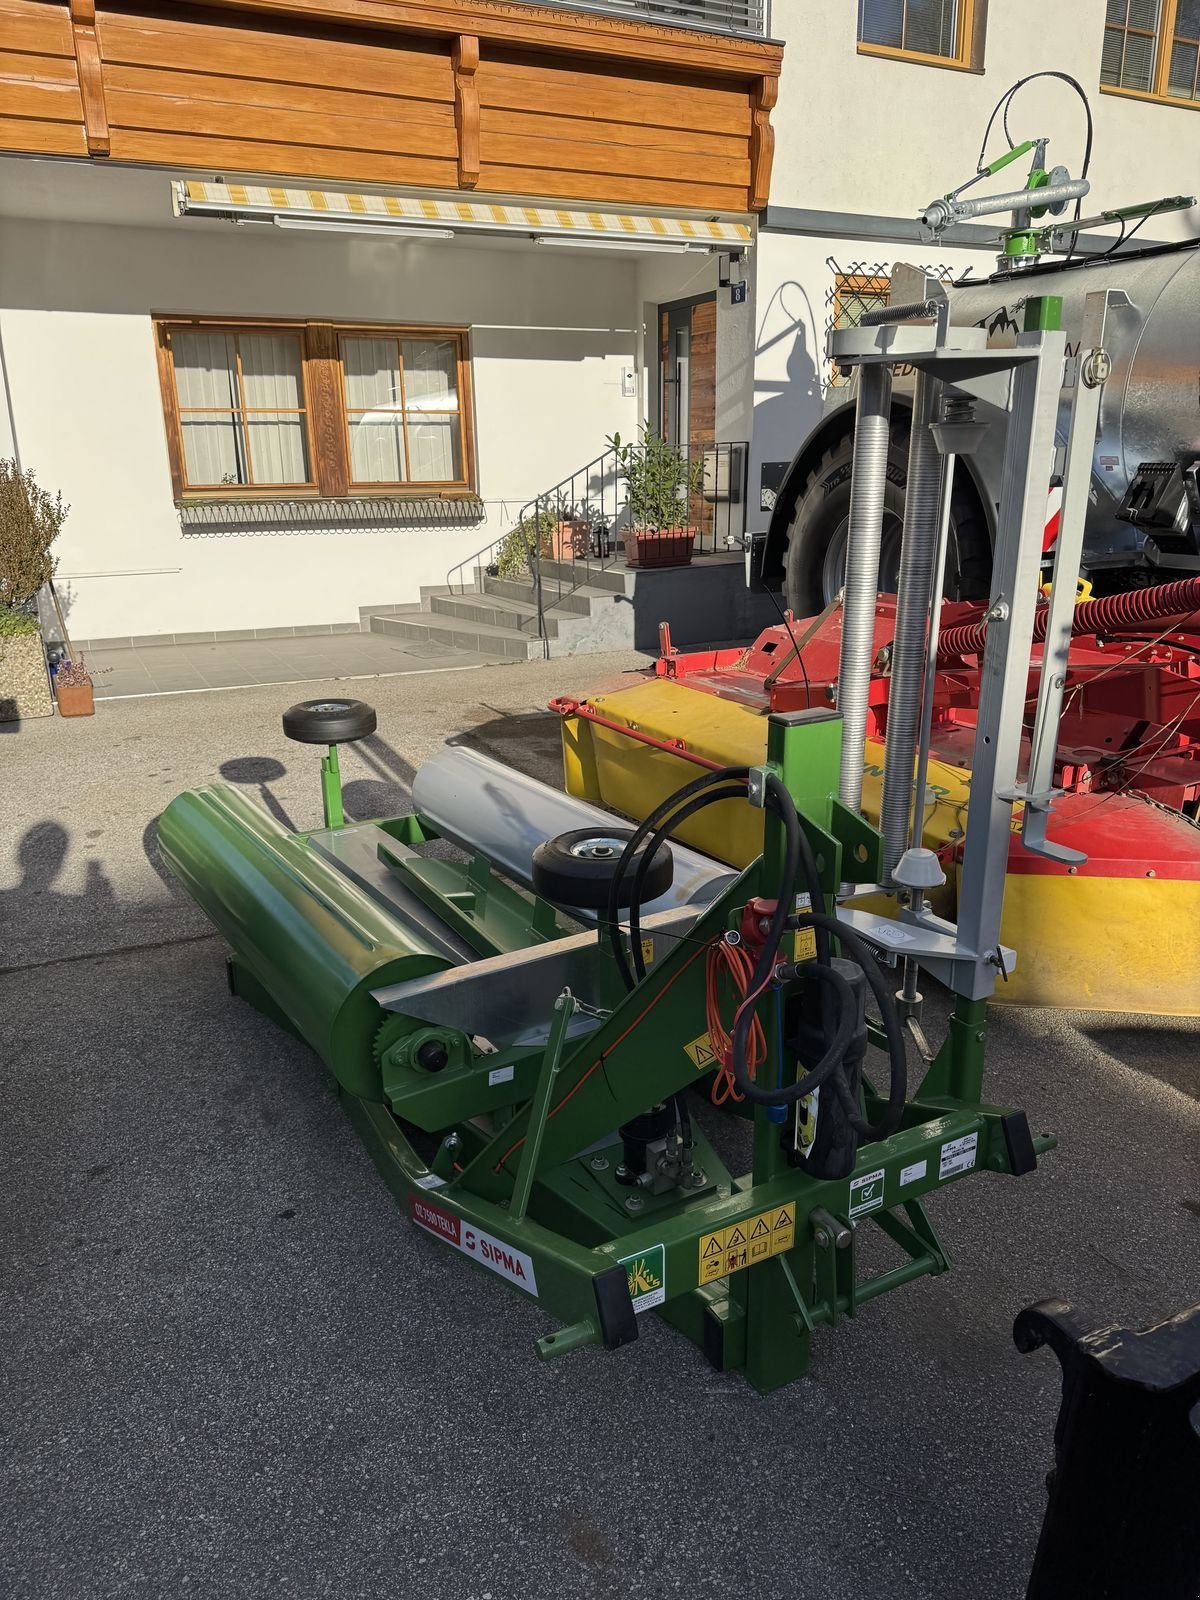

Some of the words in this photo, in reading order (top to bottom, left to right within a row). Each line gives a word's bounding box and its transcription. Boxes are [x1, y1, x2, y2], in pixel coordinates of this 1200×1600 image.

[735, 288, 741, 301] 8
[861, 1172, 882, 1183] SIPMA
[423, 1207, 438, 1227] 7500
[436, 1214, 457, 1237] TEKLA
[480, 1239, 526, 1280] SIPMA
